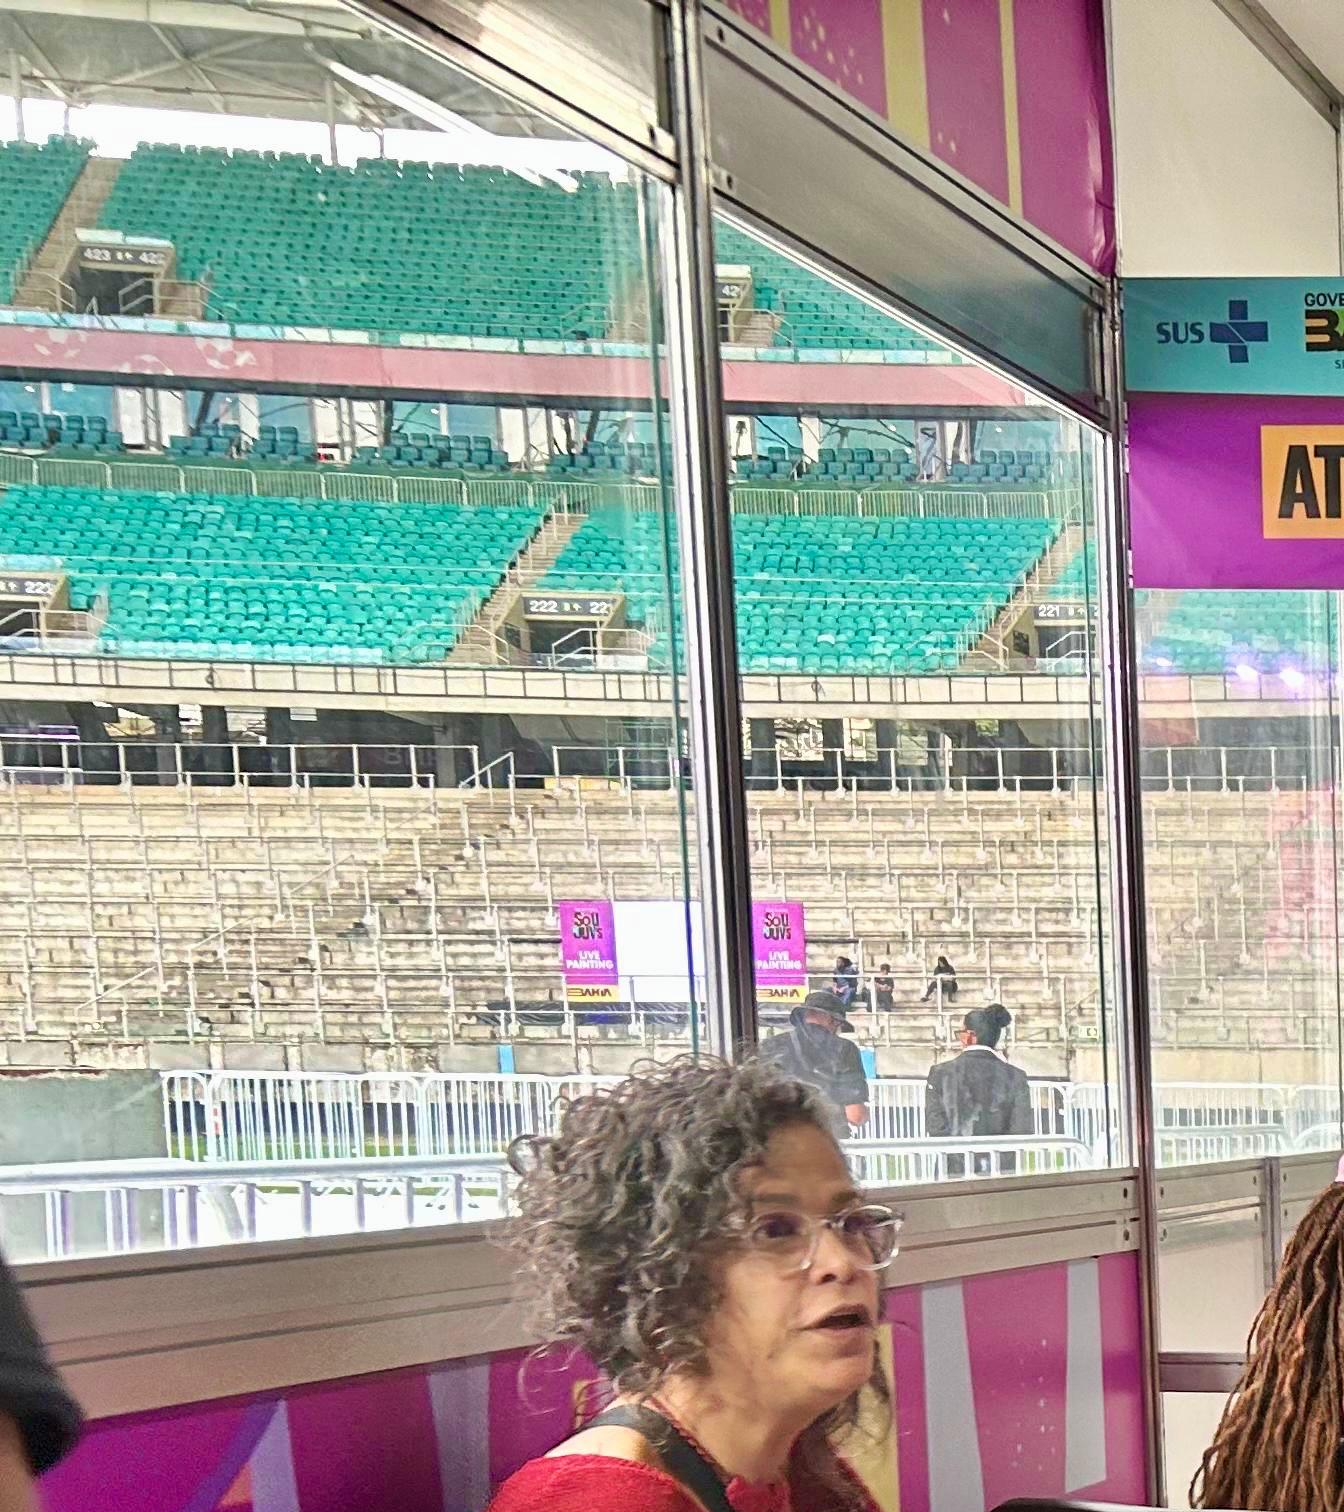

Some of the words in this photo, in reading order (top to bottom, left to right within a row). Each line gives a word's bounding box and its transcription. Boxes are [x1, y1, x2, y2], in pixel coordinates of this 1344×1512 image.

[722, 285, 741, 297] 42
[1156, 321, 1205, 344] SUS
[529, 600, 558, 613] 222
[589, 601, 609, 614] 22
[1038, 604, 1060, 617] 221
[577, 950, 600, 960] LIVE
[768, 951, 790, 960] LIVE
[566, 960, 614, 969] PAINTING
[757, 960, 802, 969] PAINTING
[567, 987, 612, 997] BAHIA
[756, 988, 800, 997] BAHIA
